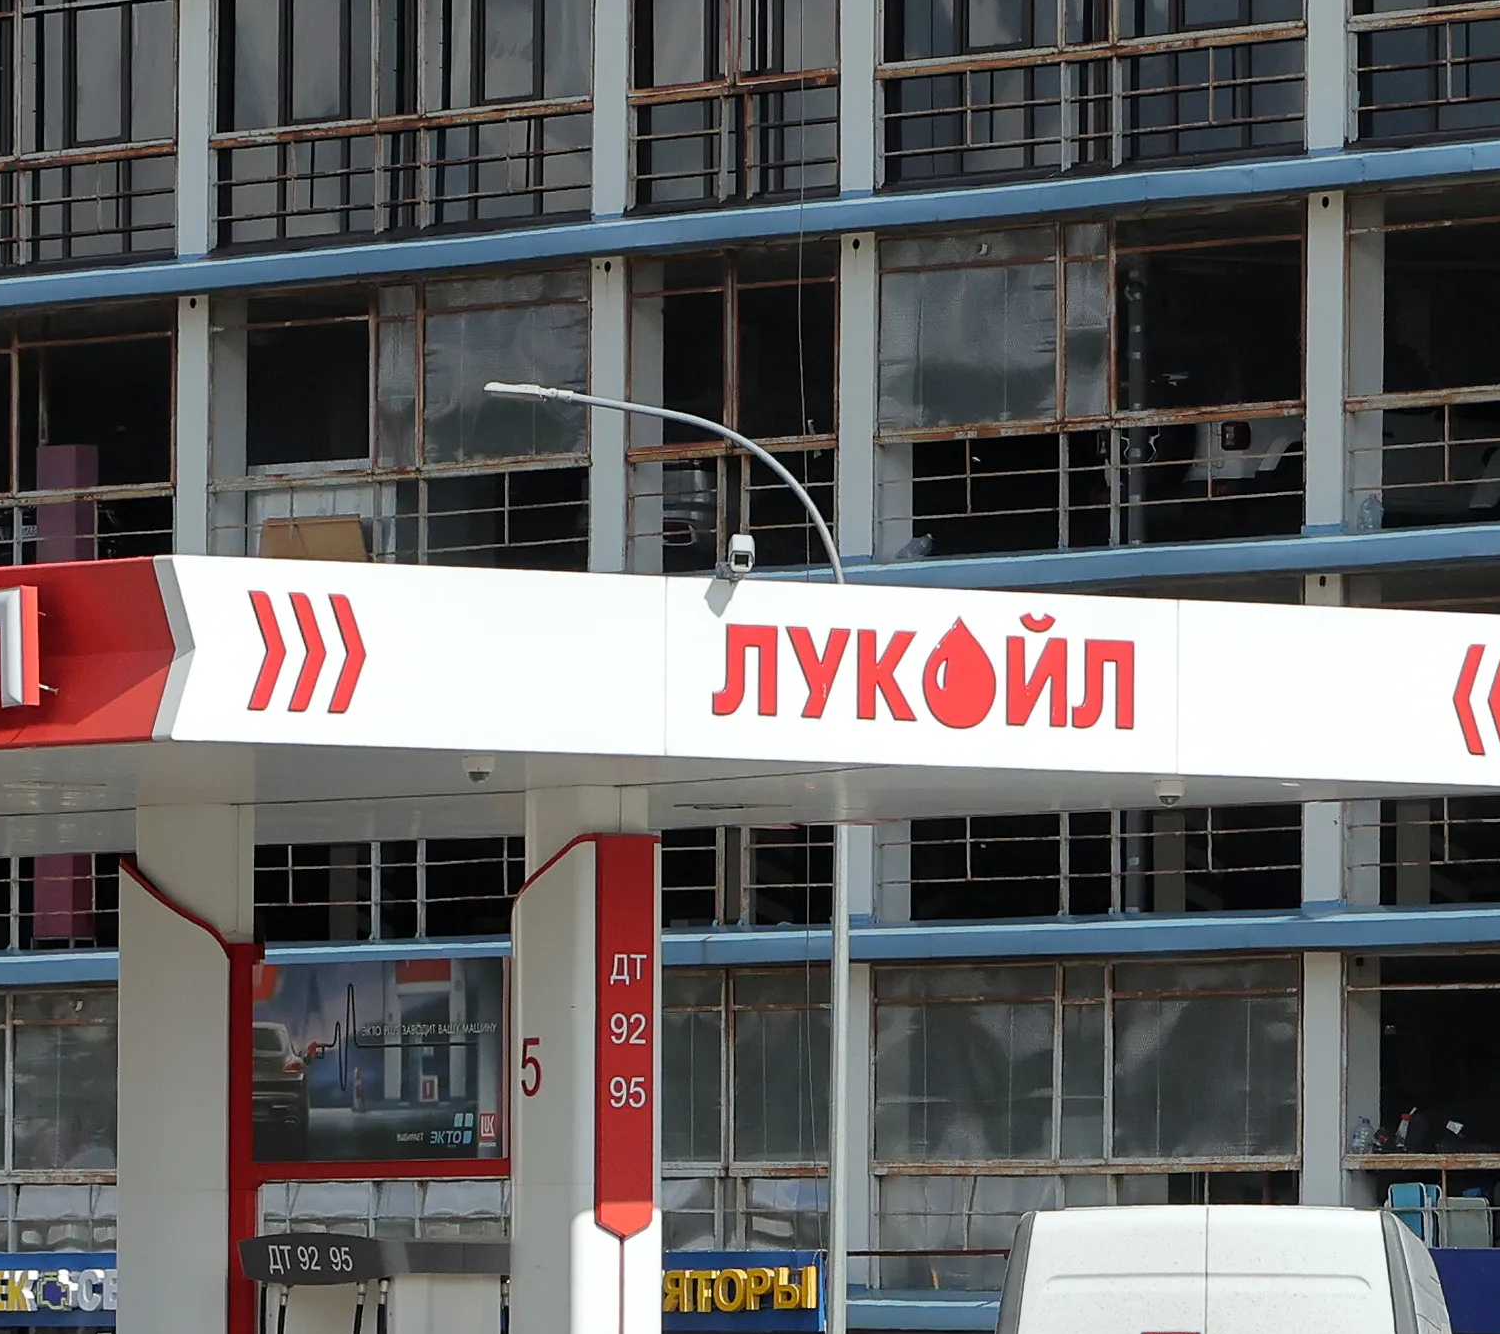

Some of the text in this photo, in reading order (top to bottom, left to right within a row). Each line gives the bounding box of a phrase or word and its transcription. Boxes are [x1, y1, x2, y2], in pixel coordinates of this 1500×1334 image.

[711, 611, 1135, 730] ЛУКОЙЛ
[610, 953, 648, 986] ДТ
[402, 1023, 436, 1037] ЗАВОДИТ
[437, 1023, 460, 1035] ВАШУ
[462, 1022, 497, 1033] МАШИНУ
[610, 1012, 647, 1045] 92
[520, 1037, 542, 1098] 5
[609, 1076, 647, 1108] 95
[430, 1130, 462, 1144] ЭКТО
[268, 1245, 353, 1275] ДТ 92 95
